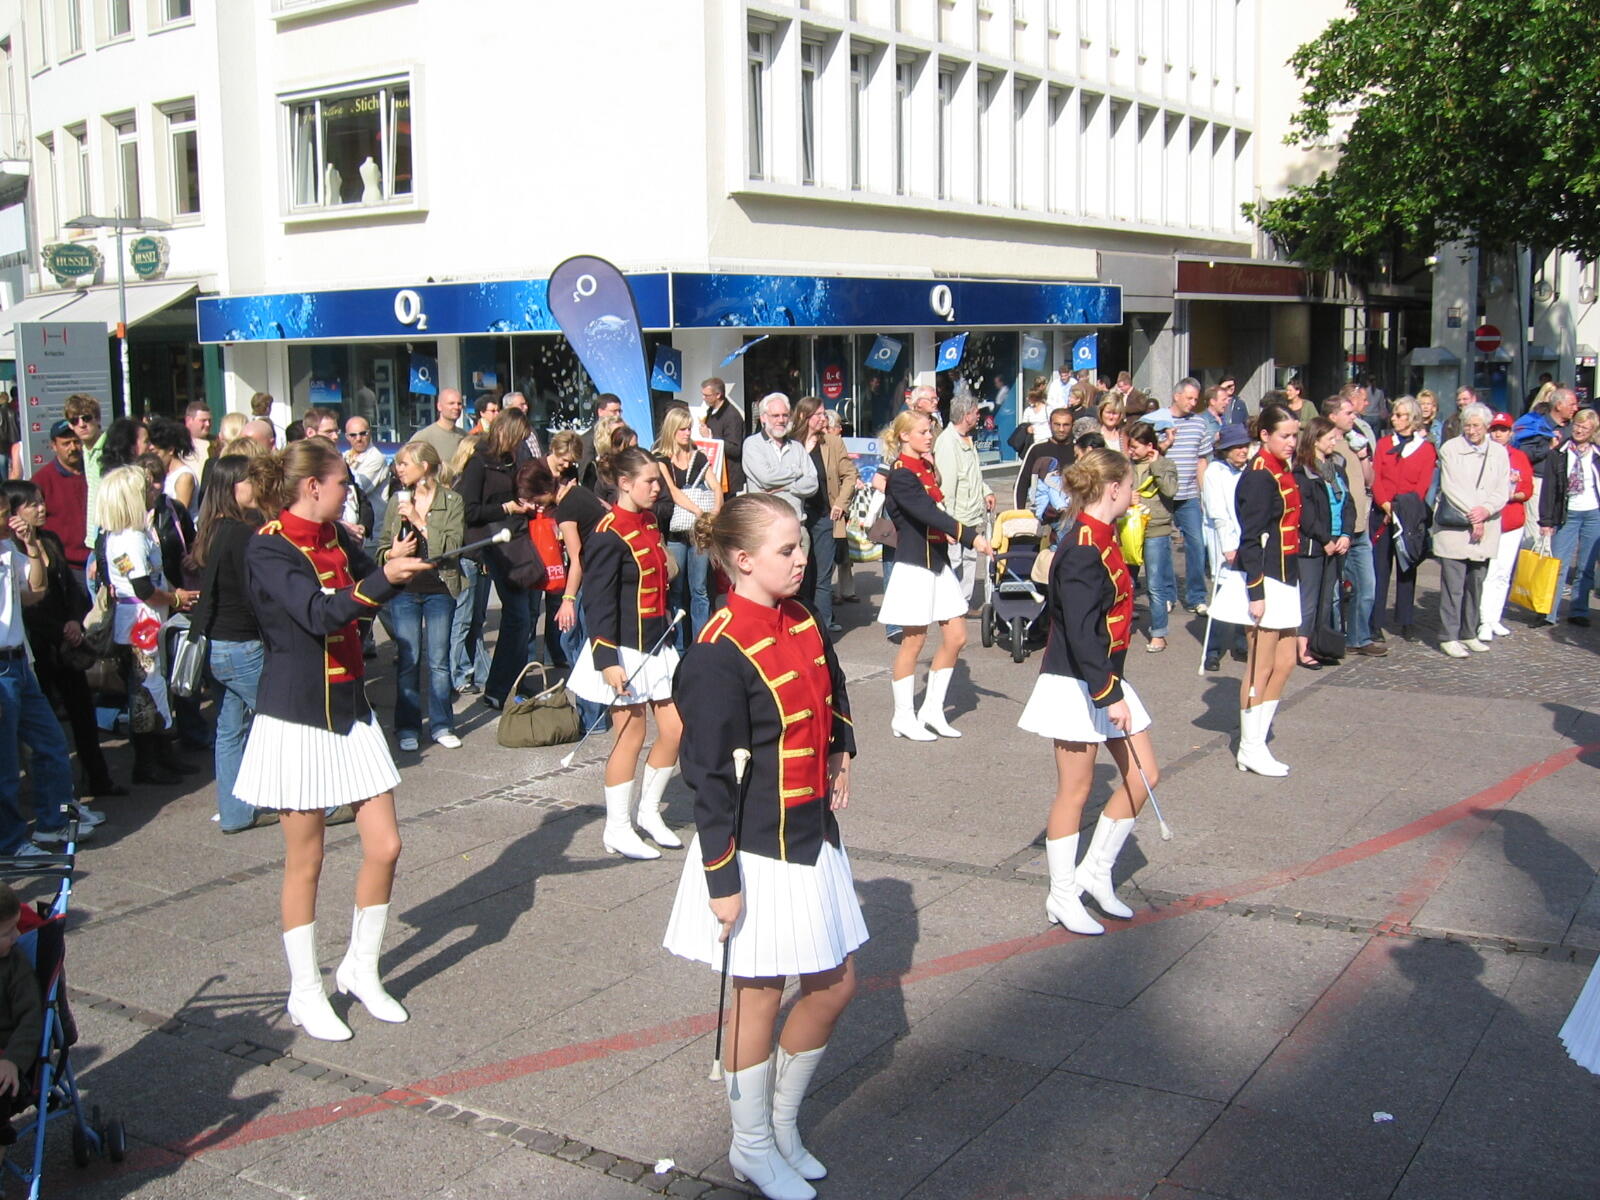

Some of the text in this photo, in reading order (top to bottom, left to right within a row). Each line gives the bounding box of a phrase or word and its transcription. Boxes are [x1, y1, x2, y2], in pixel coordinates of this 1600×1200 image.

[56, 255, 90, 267] HUSSEL
[135, 250, 156, 264] HUSSEL
[394, 289, 427, 330] O2
[930, 284, 955, 322] O2
